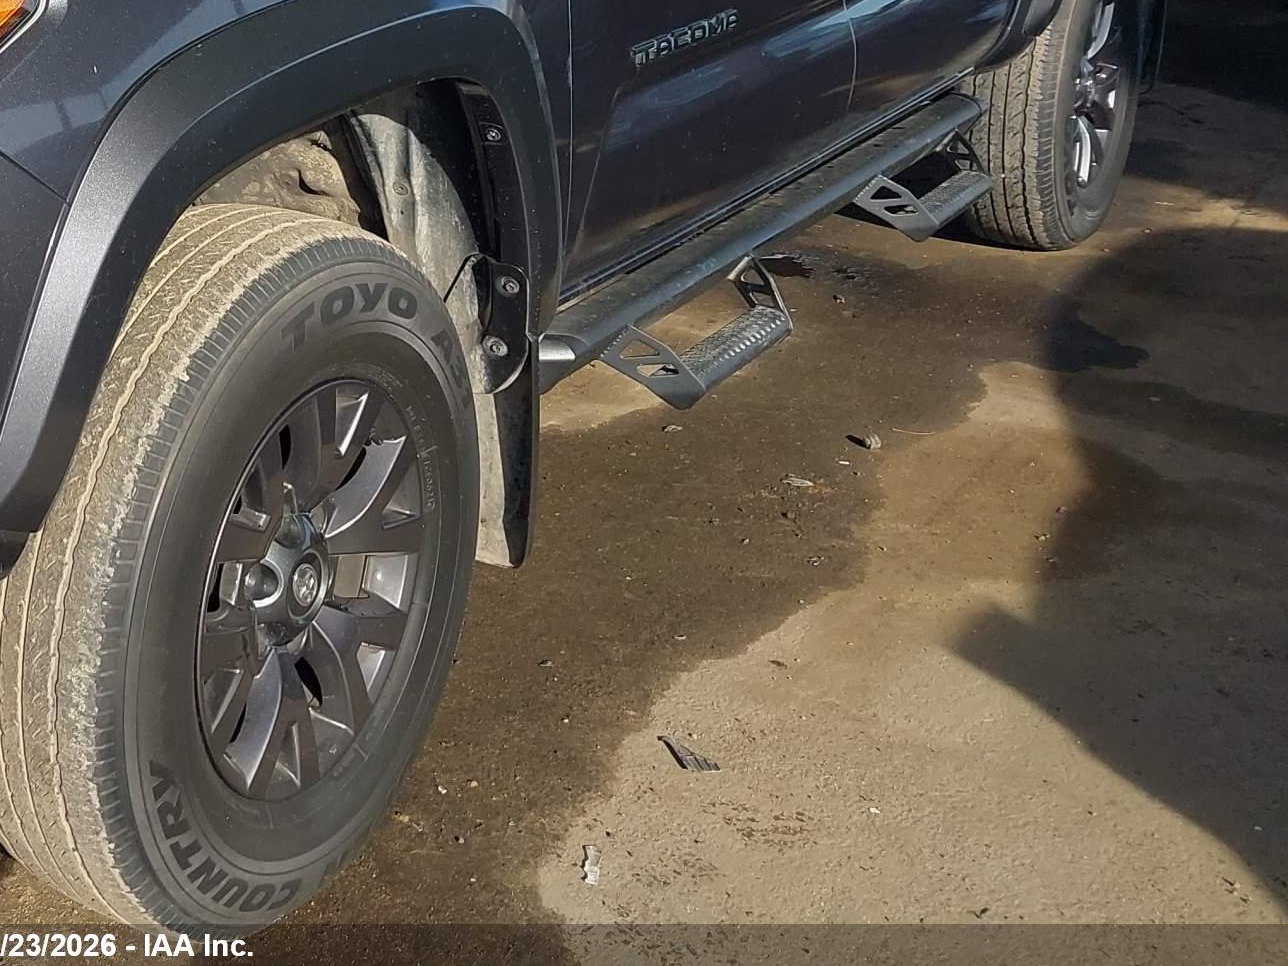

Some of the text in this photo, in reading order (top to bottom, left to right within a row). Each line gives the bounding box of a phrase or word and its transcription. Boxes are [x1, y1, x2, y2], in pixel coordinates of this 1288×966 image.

[630, 8, 739, 67] TACOMA
[281, 282, 418, 355] TOYO
[148, 761, 303, 913] COUNTRY
